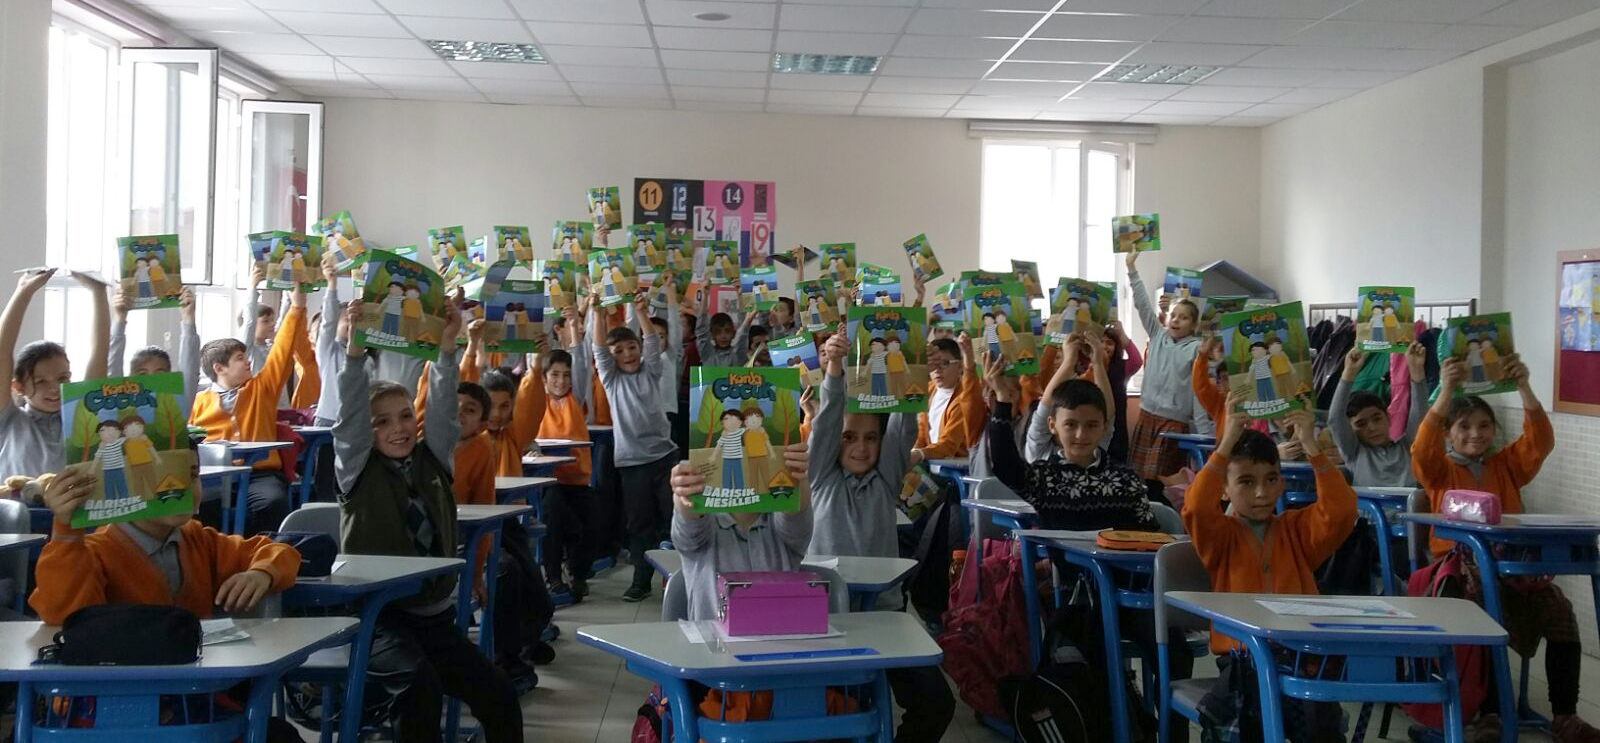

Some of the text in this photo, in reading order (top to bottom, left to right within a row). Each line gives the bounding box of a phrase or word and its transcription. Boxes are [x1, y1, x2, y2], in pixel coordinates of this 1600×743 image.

[642, 188, 657, 205] 11
[672, 186, 687, 212] 12
[725, 188, 741, 204] 14
[694, 207, 715, 232] 13
